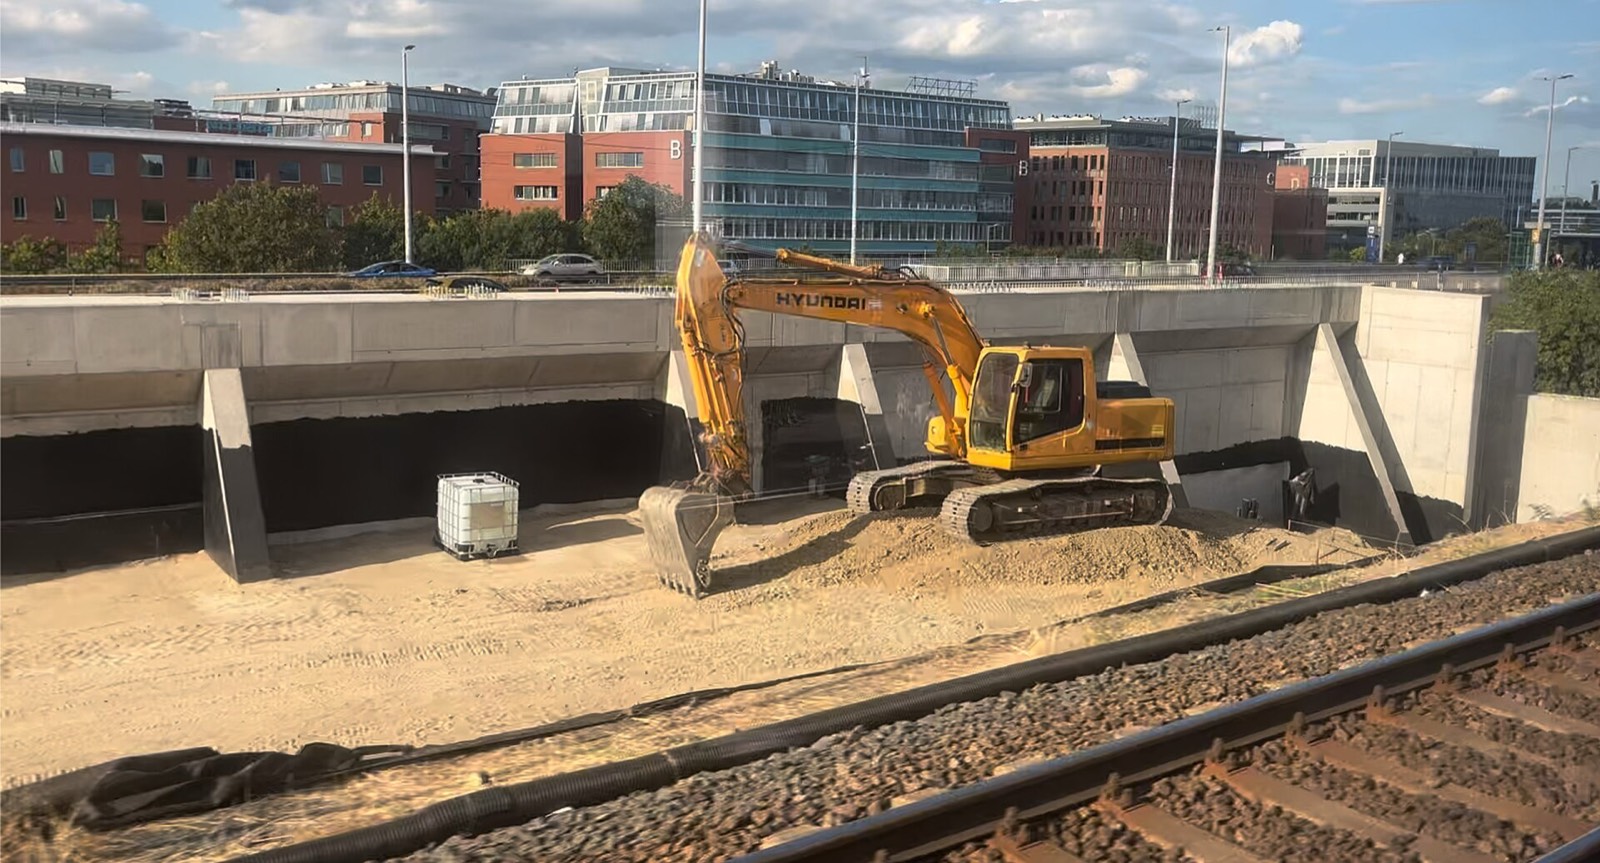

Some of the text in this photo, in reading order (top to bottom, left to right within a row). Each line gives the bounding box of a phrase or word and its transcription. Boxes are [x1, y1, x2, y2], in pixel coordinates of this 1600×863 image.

[670, 139, 681, 159] B
[1019, 160, 1028, 177] B
[1266, 172, 1275, 186] C
[776, 292, 866, 310] HYUNDAI
